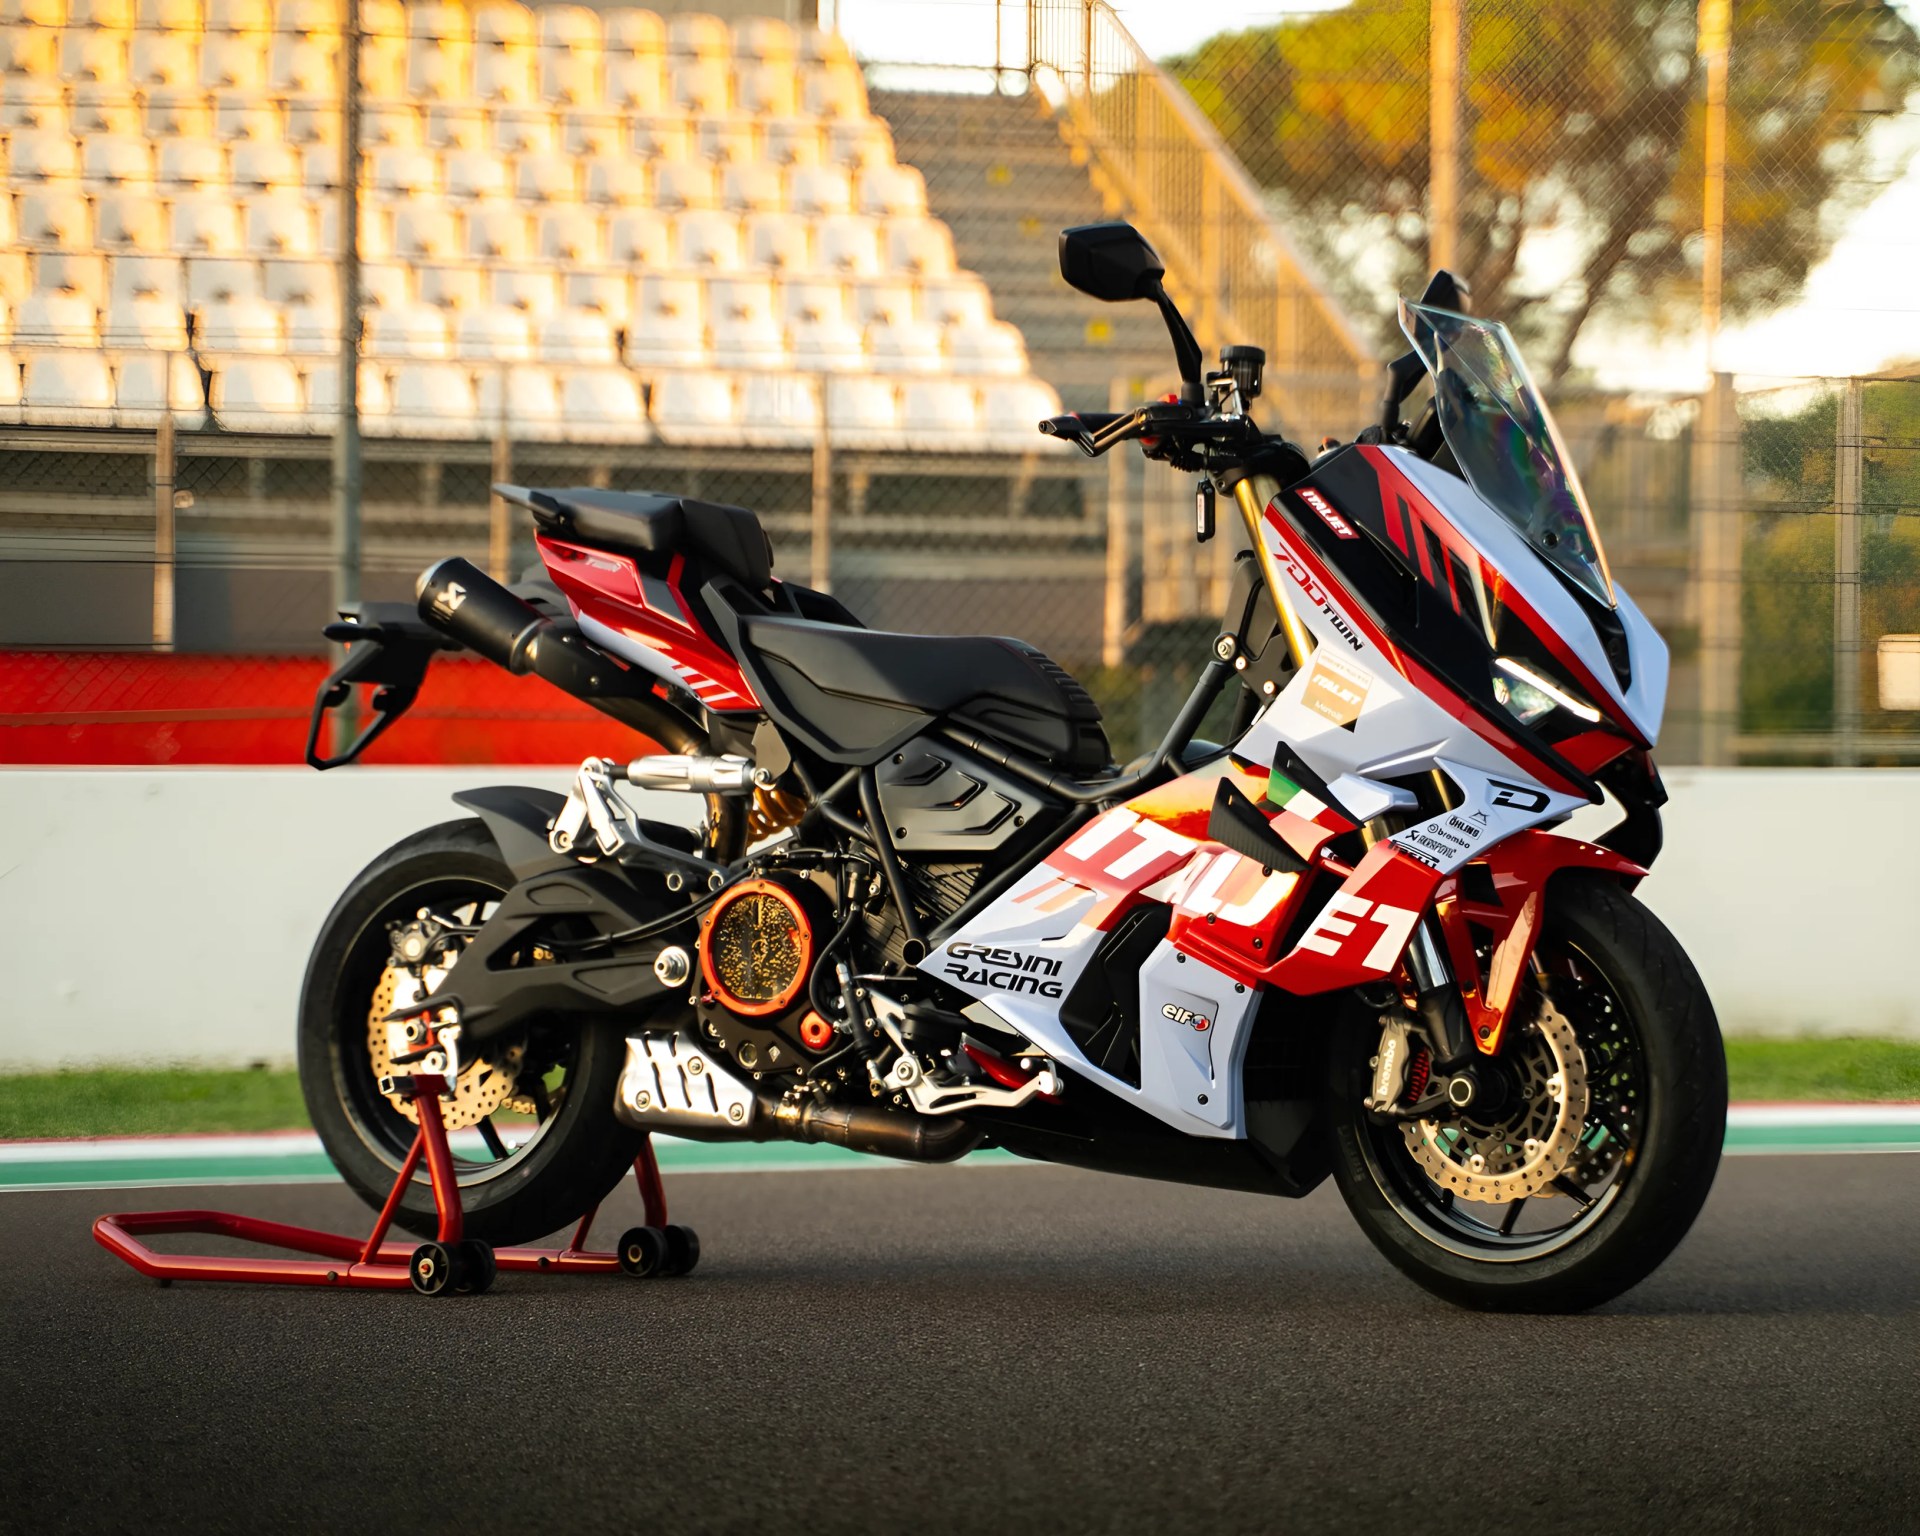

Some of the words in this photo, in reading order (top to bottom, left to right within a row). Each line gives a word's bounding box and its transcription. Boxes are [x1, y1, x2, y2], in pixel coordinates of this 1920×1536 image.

[1302, 490, 1353, 537] ITALJET
[1322, 603, 1366, 652] TWIN
[1437, 828, 1471, 849] brembo
[946, 941, 1063, 977] GRESINI
[943, 962, 1064, 999] RACING
[1161, 1003, 1195, 1025] elf
[1376, 1039, 1397, 1096] brembo
